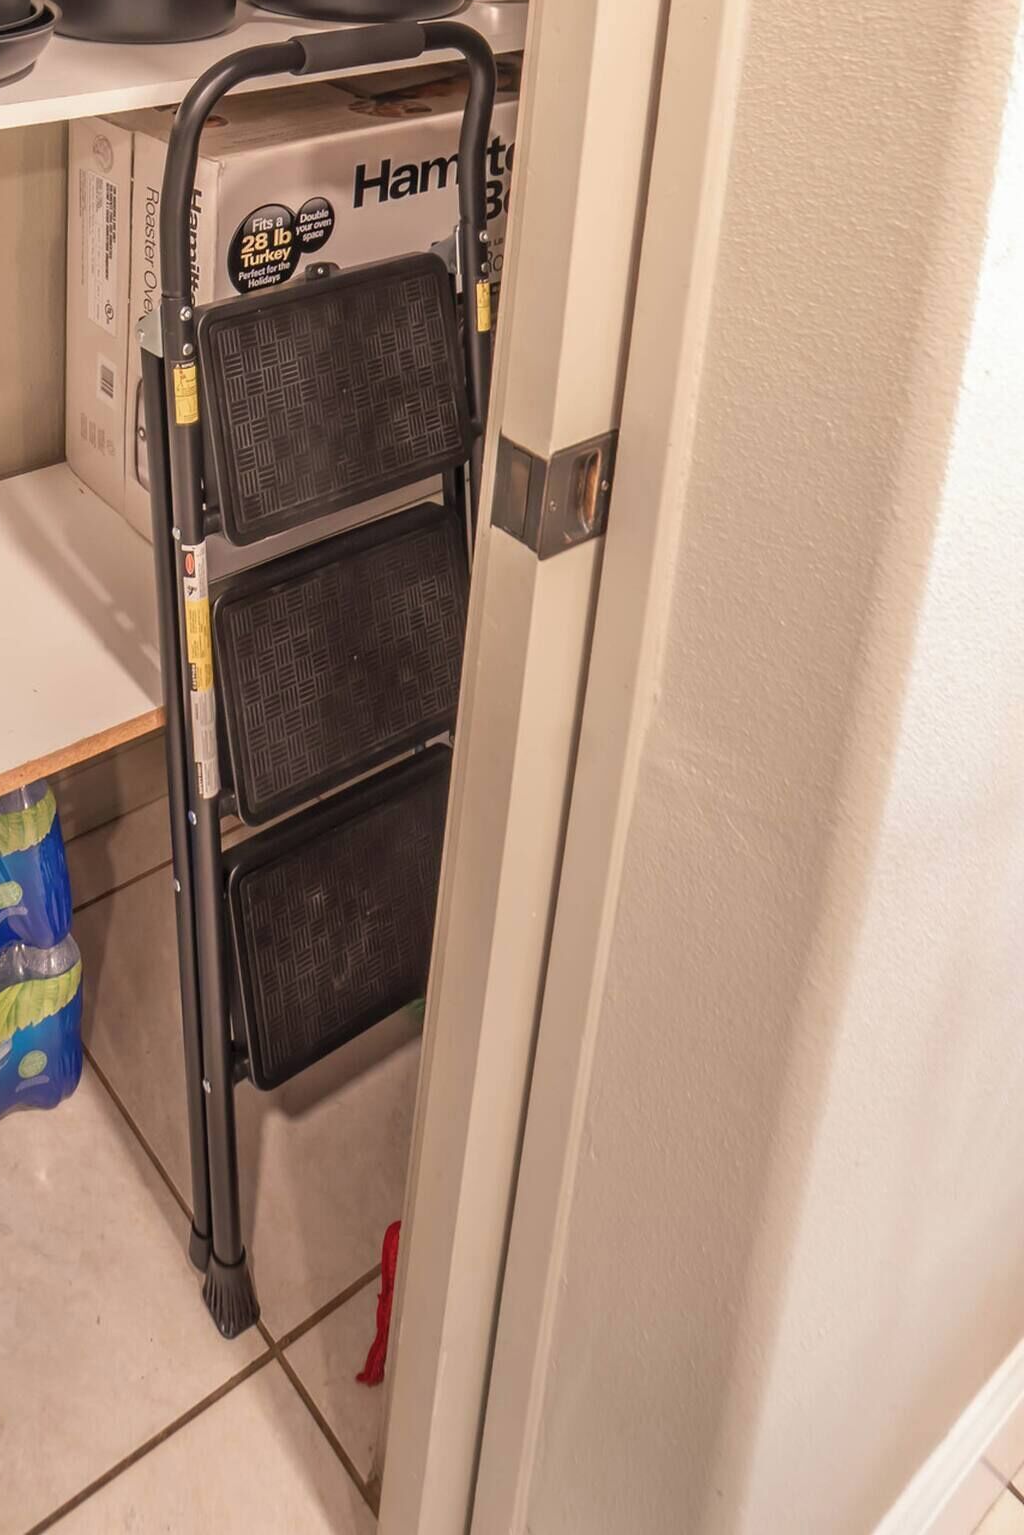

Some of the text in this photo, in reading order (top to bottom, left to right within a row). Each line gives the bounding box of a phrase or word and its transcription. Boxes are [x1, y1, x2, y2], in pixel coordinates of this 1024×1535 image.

[252, 216, 284, 233] Fits a
[300, 209, 330, 223] Double
[144, 186, 160, 268] Roaster
[296, 218, 332, 235] your oven
[241, 228, 292, 254] 28 lb
[302, 229, 324, 242] space
[241, 246, 292, 268] Turkey
[238, 261, 291, 281] Perfect for the
[248, 274, 281, 289] Holidays
